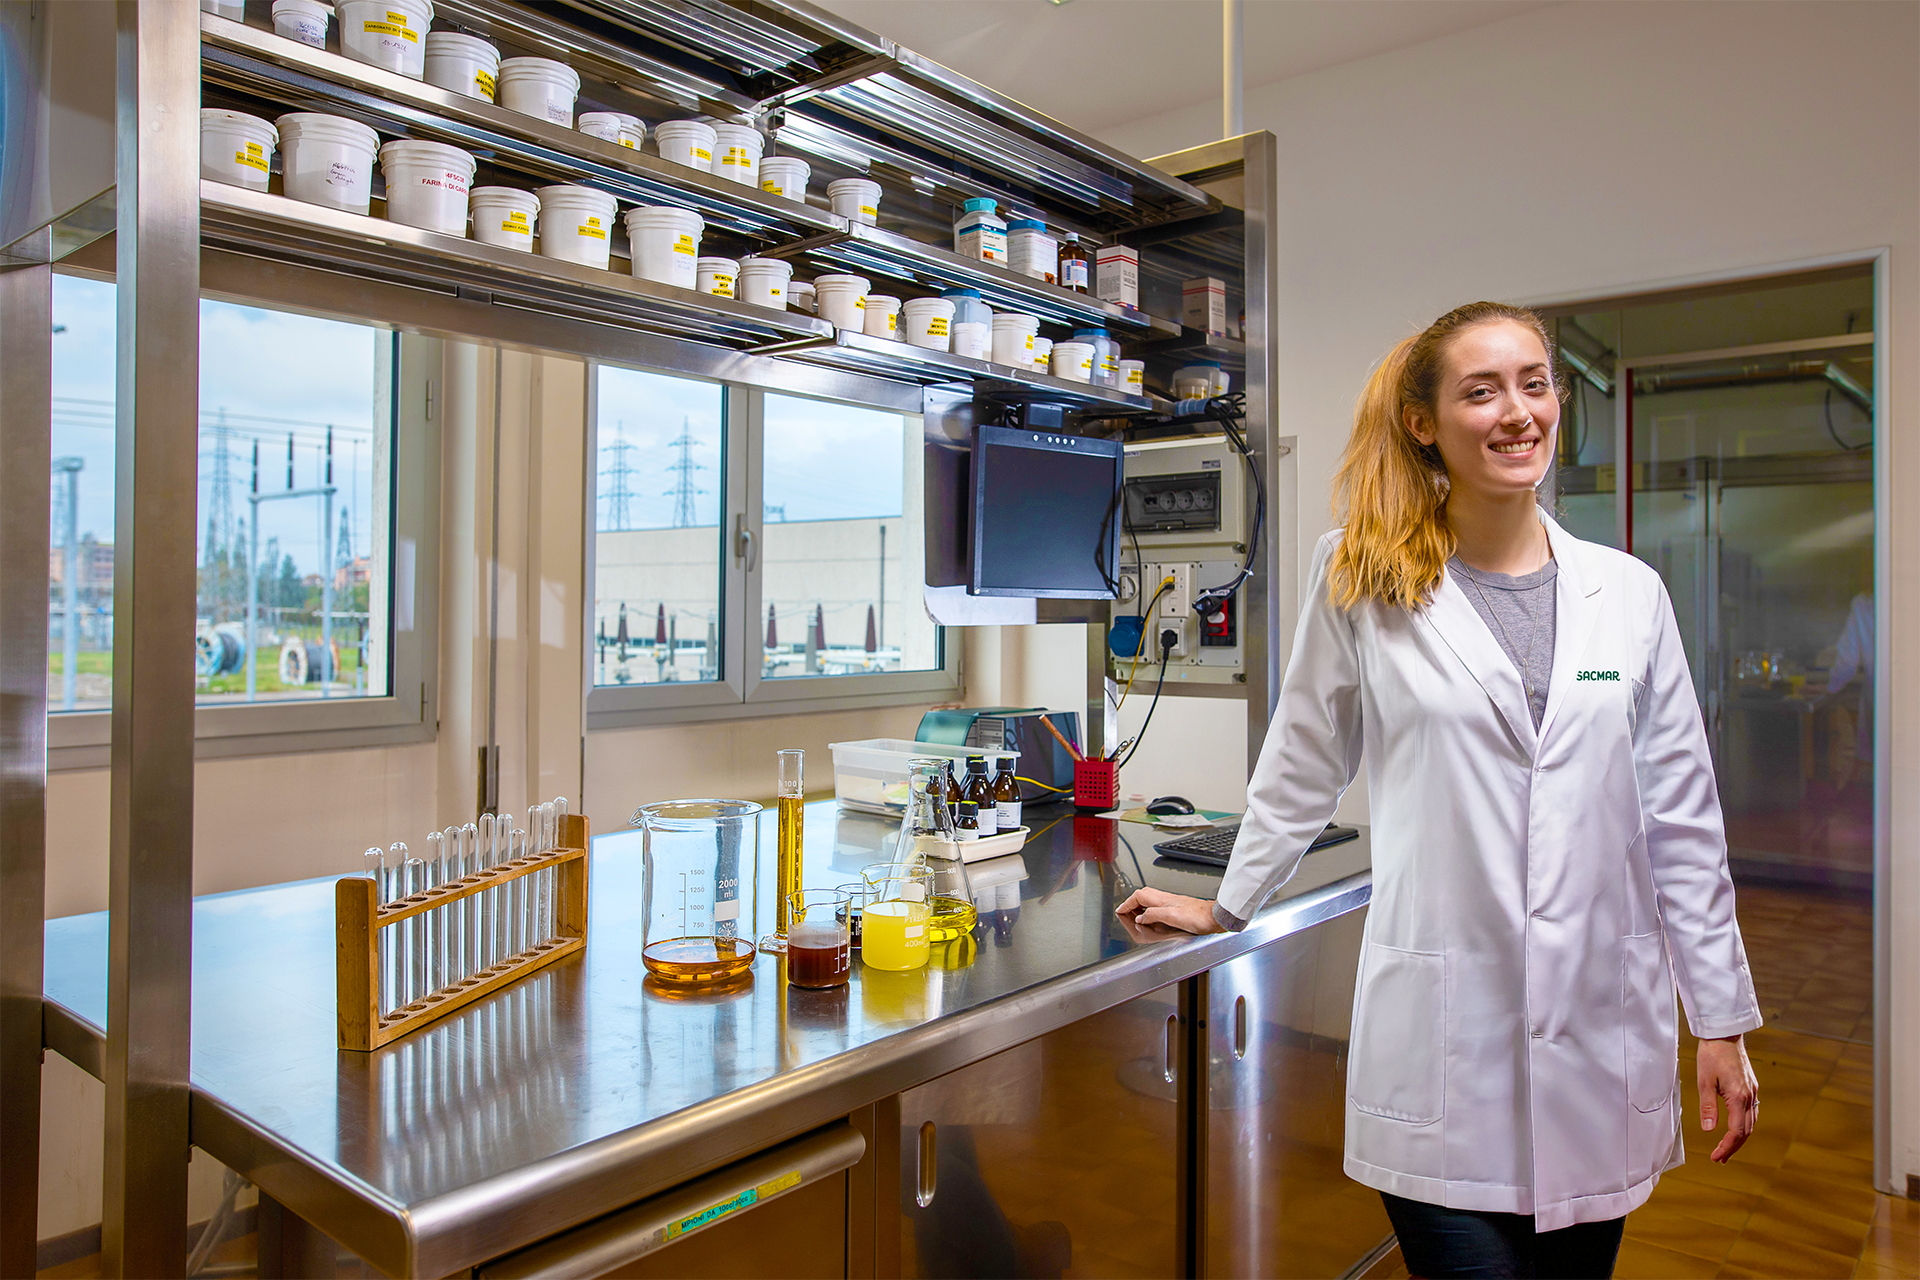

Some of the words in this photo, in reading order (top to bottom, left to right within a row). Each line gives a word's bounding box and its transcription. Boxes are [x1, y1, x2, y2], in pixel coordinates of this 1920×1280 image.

[364, 23, 392, 31] CARBONATO
[422, 178, 447, 188] FARINA
[1576, 670, 1621, 682] SACMAR
[784, 780, 798, 788] 100
[718, 877, 739, 889] 2000
[904, 914, 924, 924] PYREX
[904, 937, 924, 948] 400ml
[706, 1209, 716, 1219] DA
